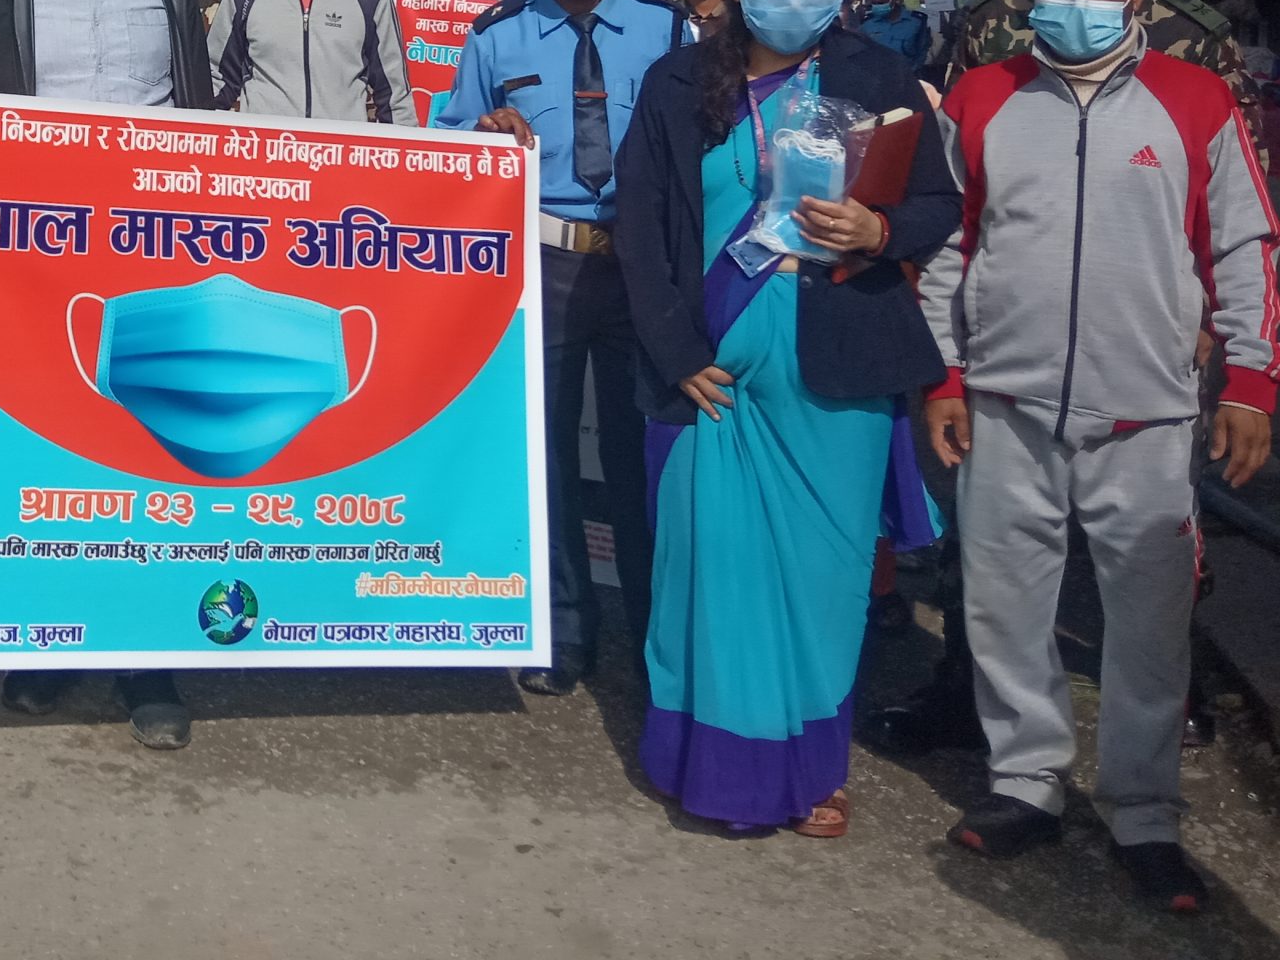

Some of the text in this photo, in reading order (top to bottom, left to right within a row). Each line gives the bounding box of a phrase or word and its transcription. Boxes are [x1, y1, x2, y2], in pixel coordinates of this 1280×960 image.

[415, 17, 450, 33] मास्क
[1, 110, 91, 147] नियन्त्रण
[96, 126, 111, 150] र
[117, 121, 218, 156] रोकथाममा
[223, 129, 259, 160] मेरो
[265, 132, 344, 172] प्रतिबद्धता
[348, 145, 400, 169] मास्क
[405, 148, 473, 181] लगाउनु
[476, 147, 493, 176] नै
[498, 150, 521, 178] हो
[1129, 158, 1162, 168] adidas
[132, 165, 311, 202] आजको आवश्यकता
[109, 206, 271, 266] मास्क
[285, 205, 512, 277] अभियान
[20, 487, 136, 524] श्रावण
[145, 492, 195, 527] २३
[247, 493, 303, 528] २९,
[315, 494, 406, 527] २०७८
[32, 540, 80, 559] मास्क
[83, 537, 148, 564] लगाउँछु
[151, 542, 164, 561] र
[234, 540, 264, 561] पनि
[268, 543, 312, 562] मास्क
[315, 543, 370, 562] लगाउन
[374, 540, 410, 563] प्रेरित
[414, 540, 442, 564] गर्छु
[27, 624, 86, 649] जुम्ला
[263, 619, 318, 642] नेपाल
[323, 622, 389, 642] पत्रकार
[471, 623, 526, 646] जुम्ला
